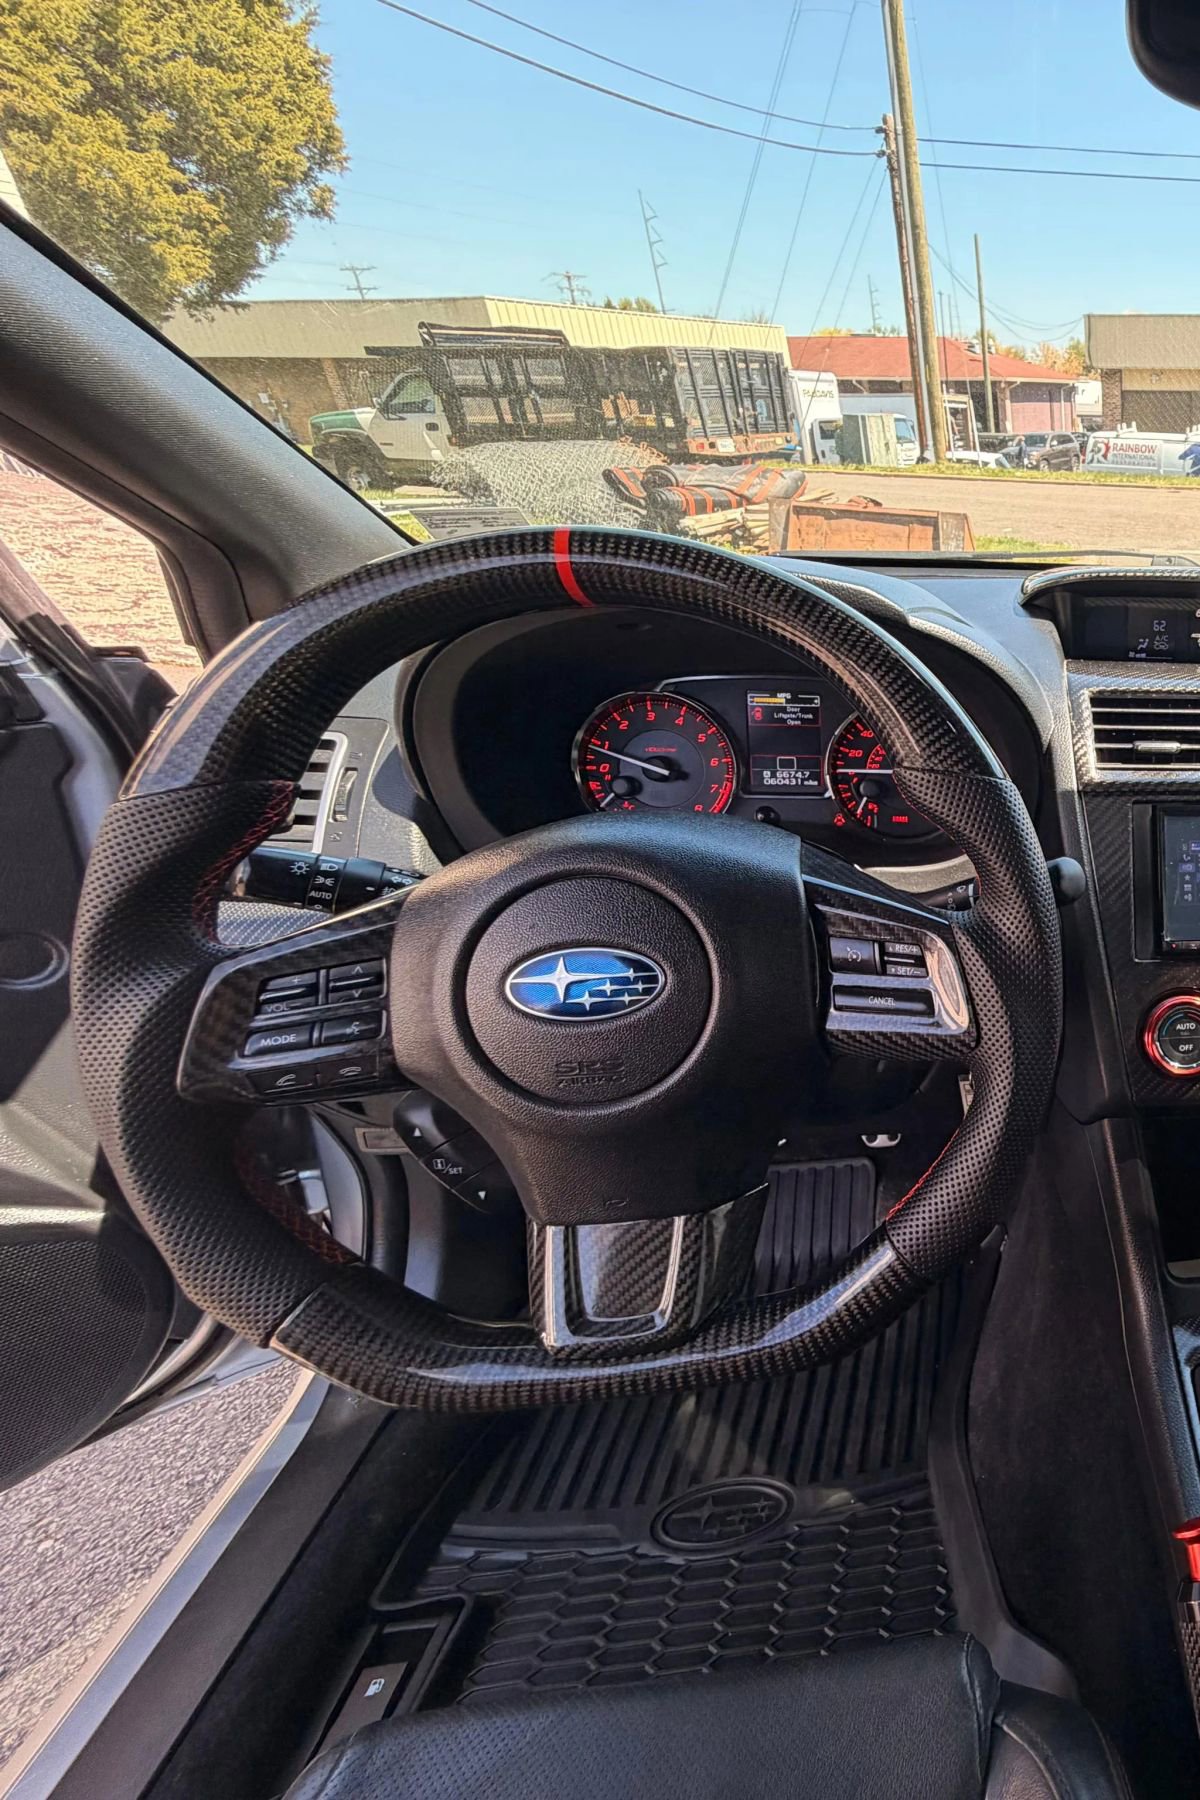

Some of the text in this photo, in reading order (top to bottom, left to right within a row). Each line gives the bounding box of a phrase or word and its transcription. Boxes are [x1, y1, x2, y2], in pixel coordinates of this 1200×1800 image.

[1112, 443, 1158, 454] RAINBOW
[1153, 620, 1166, 631] 62
[647, 712, 656, 721] 3
[675, 716, 684, 726] 4
[619, 721, 629, 730] 2
[698, 734, 706, 743] 5
[848, 749, 863, 757] 20
[710, 758, 719, 766] 6
[600, 763, 610, 773] 0
[710, 785, 718, 793] 7
[308, 890, 333, 900] AUTO
[868, 996, 896, 1006] CANCEL
[1176, 1022, 1197, 1031] AUTO
[260, 1034, 297, 1046] MODE
[1179, 1044, 1194, 1052] OFF
